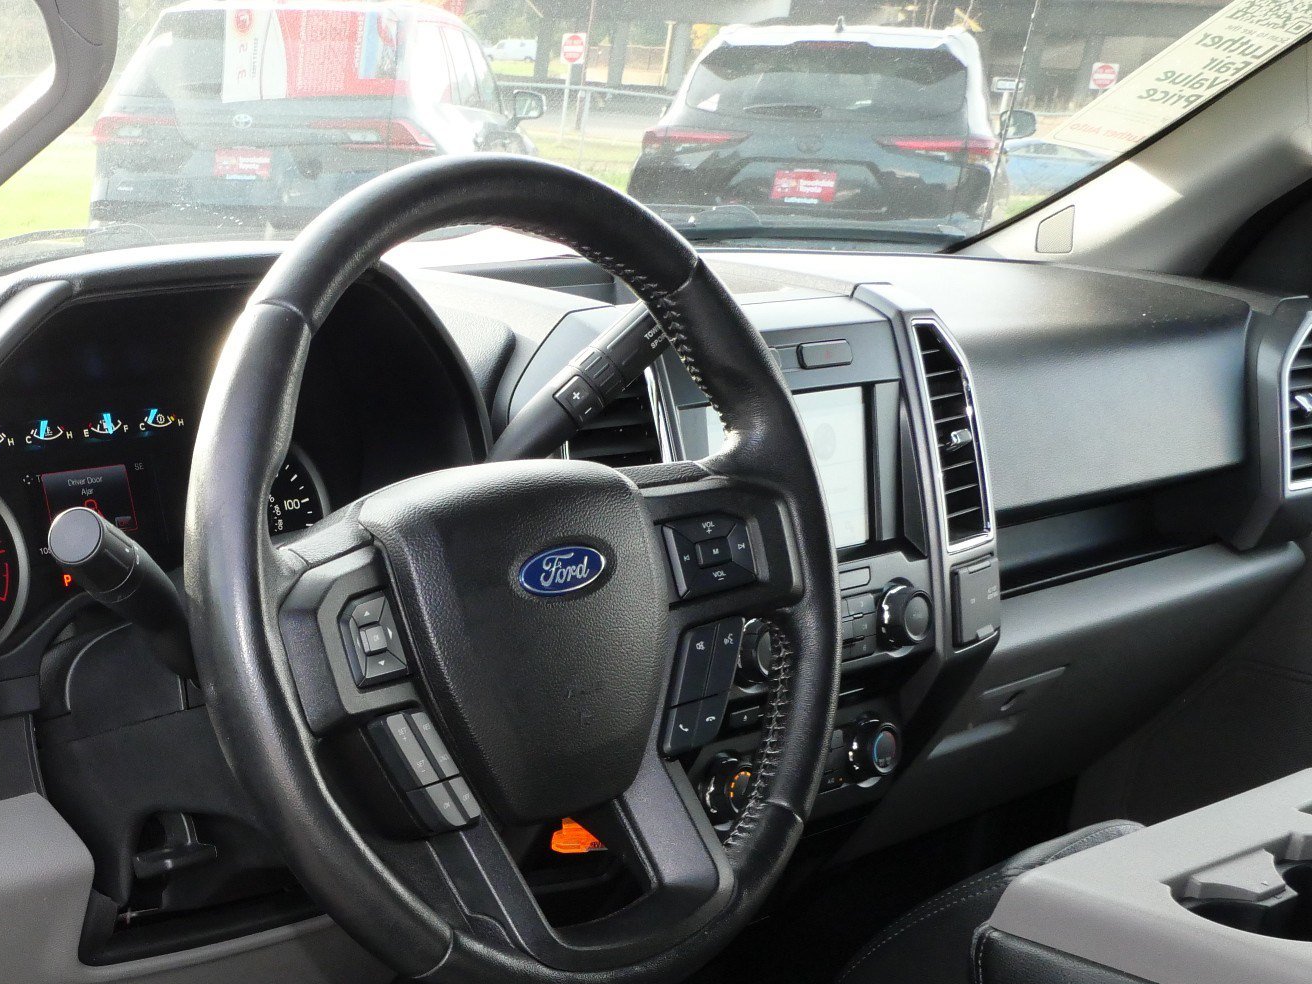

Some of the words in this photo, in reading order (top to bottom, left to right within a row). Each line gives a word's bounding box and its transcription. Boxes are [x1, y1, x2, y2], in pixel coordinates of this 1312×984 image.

[139, 422, 146, 431] C
[177, 418, 184, 427] H
[83, 429, 90, 437] E
[123, 424, 129, 433] F
[66, 431, 73, 439] H
[7, 438, 14, 446] H
[25, 436, 32, 444] C
[68, 477, 86, 487] Driver
[87, 476, 103, 485] Door
[81, 488, 94, 497] Ajar
[284, 498, 301, 511] 100
[701, 521, 715, 529] VOL
[539, 552, 590, 587] Ford
[712, 570, 727, 578] VOL
[63, 574, 72, 587] P
